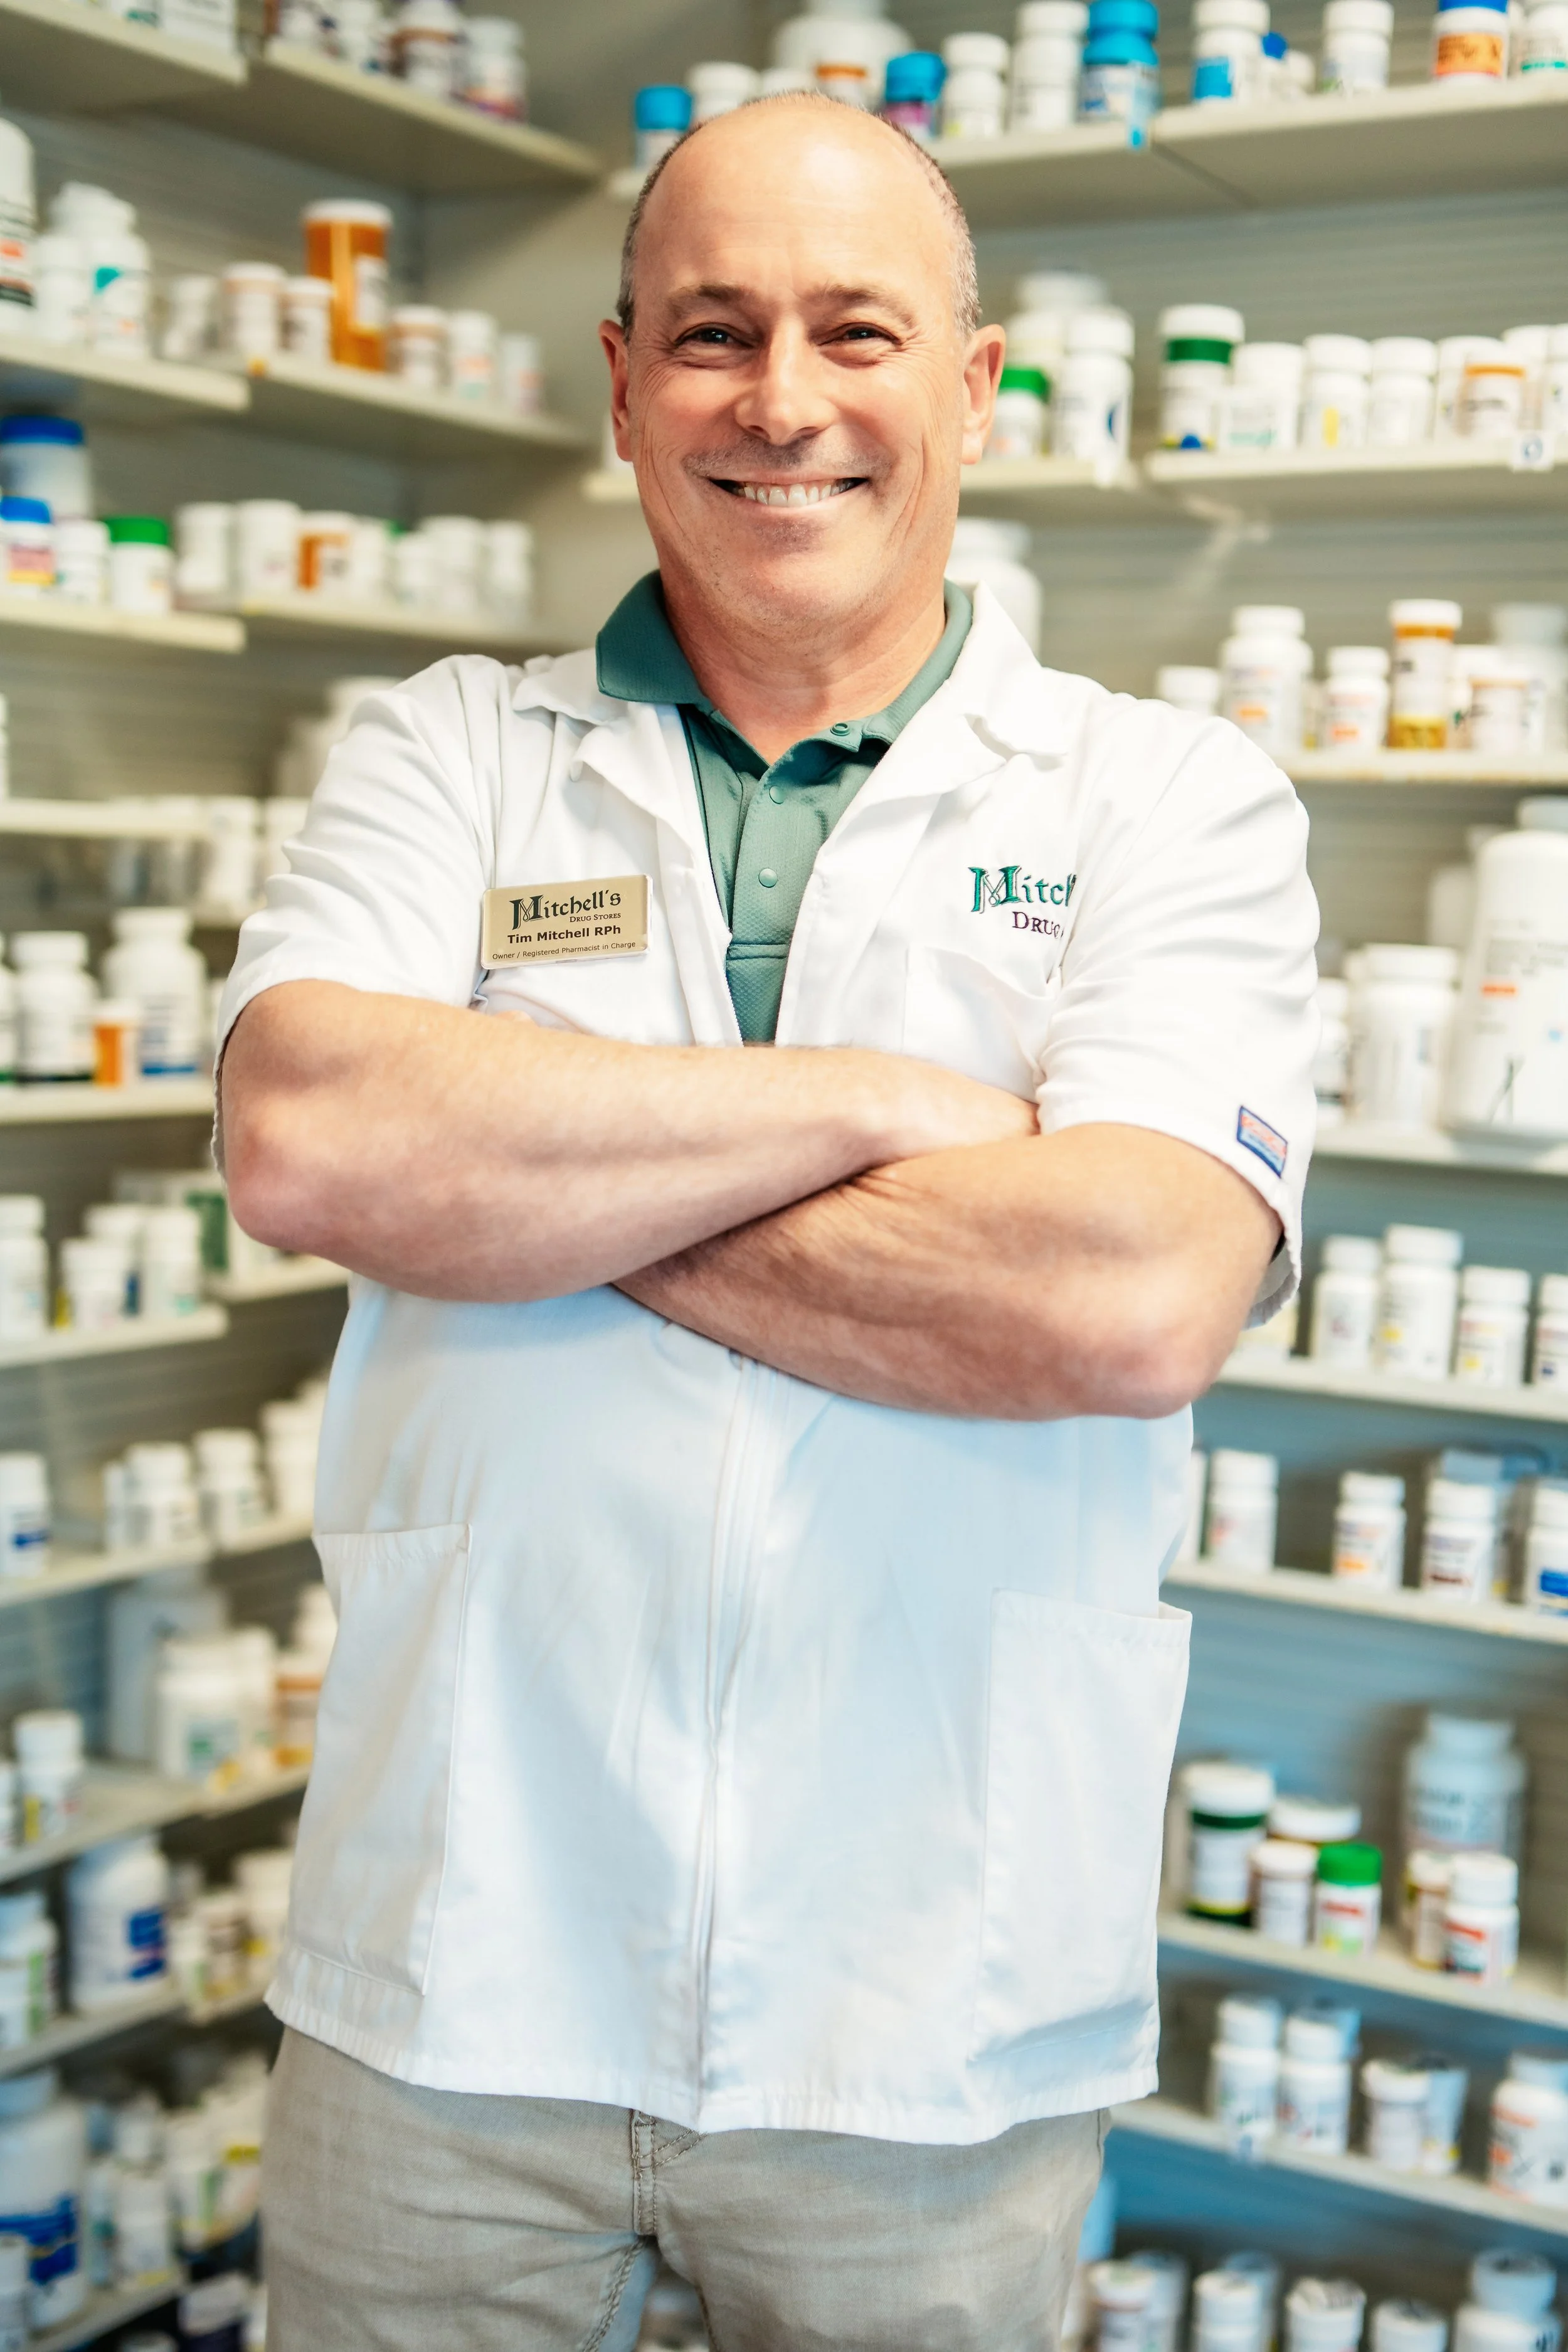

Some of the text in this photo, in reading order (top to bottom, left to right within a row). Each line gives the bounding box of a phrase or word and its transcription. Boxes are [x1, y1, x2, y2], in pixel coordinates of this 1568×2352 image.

[509, 889, 621, 930] Mitchell's
[593, 913, 621, 921] STORES
[507, 925, 621, 944] Tim Mitchell RPh
[522, 948, 559, 958] Registered
[561, 945, 600, 953] Pharmacist
[611, 941, 636, 950] Charge
